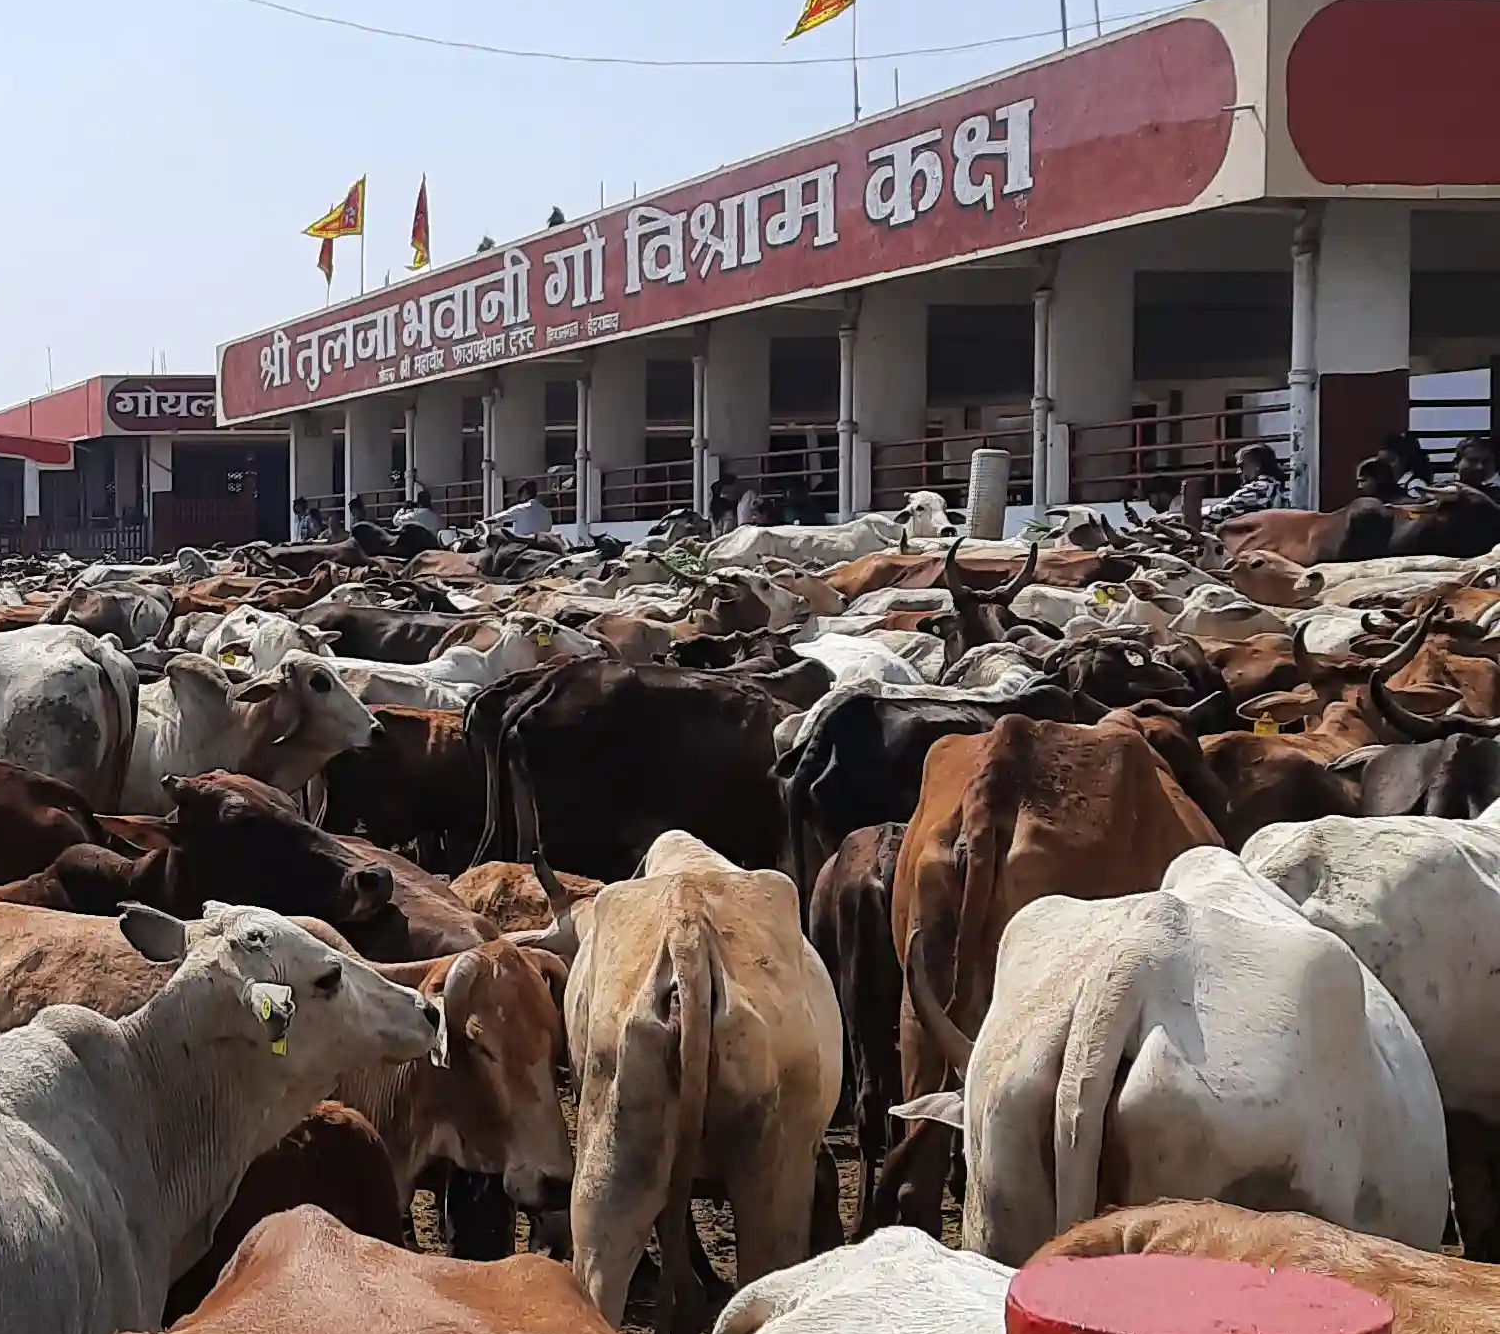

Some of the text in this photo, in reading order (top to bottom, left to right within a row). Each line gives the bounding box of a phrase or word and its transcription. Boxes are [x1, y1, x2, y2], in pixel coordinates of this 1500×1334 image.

[260, 329, 291, 391] श्री
[544, 221, 606, 307] गौ
[624, 163, 839, 296] विश्राम
[864, 97, 1036, 227] कक्ष
[414, 345, 445, 377] महावीर
[114, 385, 216, 418] गोयल
